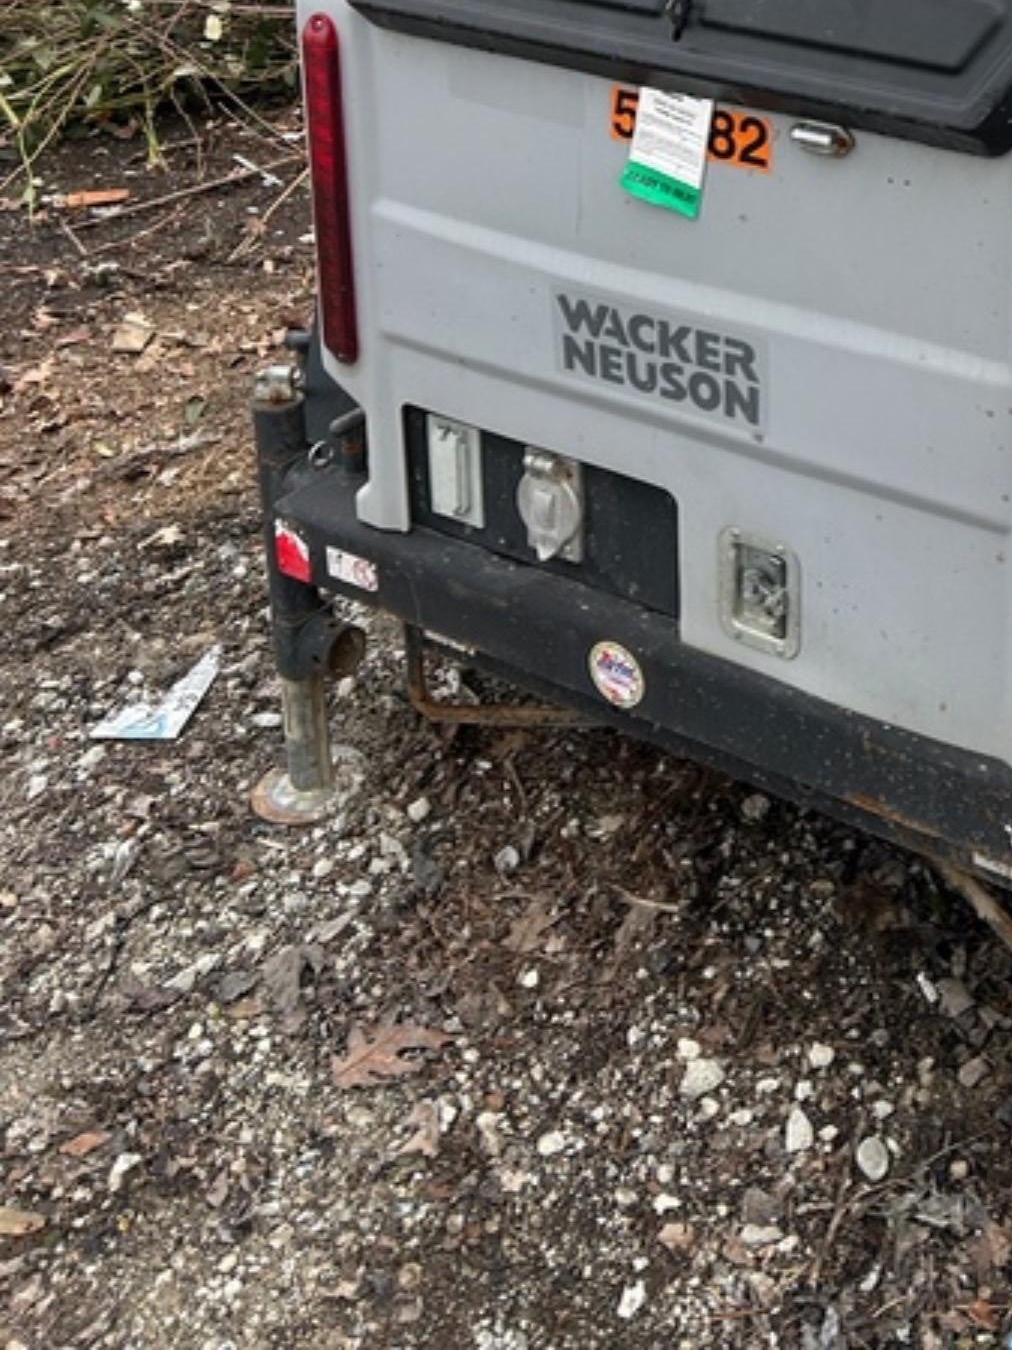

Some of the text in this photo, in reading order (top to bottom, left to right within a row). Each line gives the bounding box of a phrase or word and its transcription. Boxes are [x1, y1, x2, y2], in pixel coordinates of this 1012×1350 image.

[612, 90, 769, 168] 582
[556, 293, 760, 385] WACKER
[562, 333, 761, 426] NEUSON
